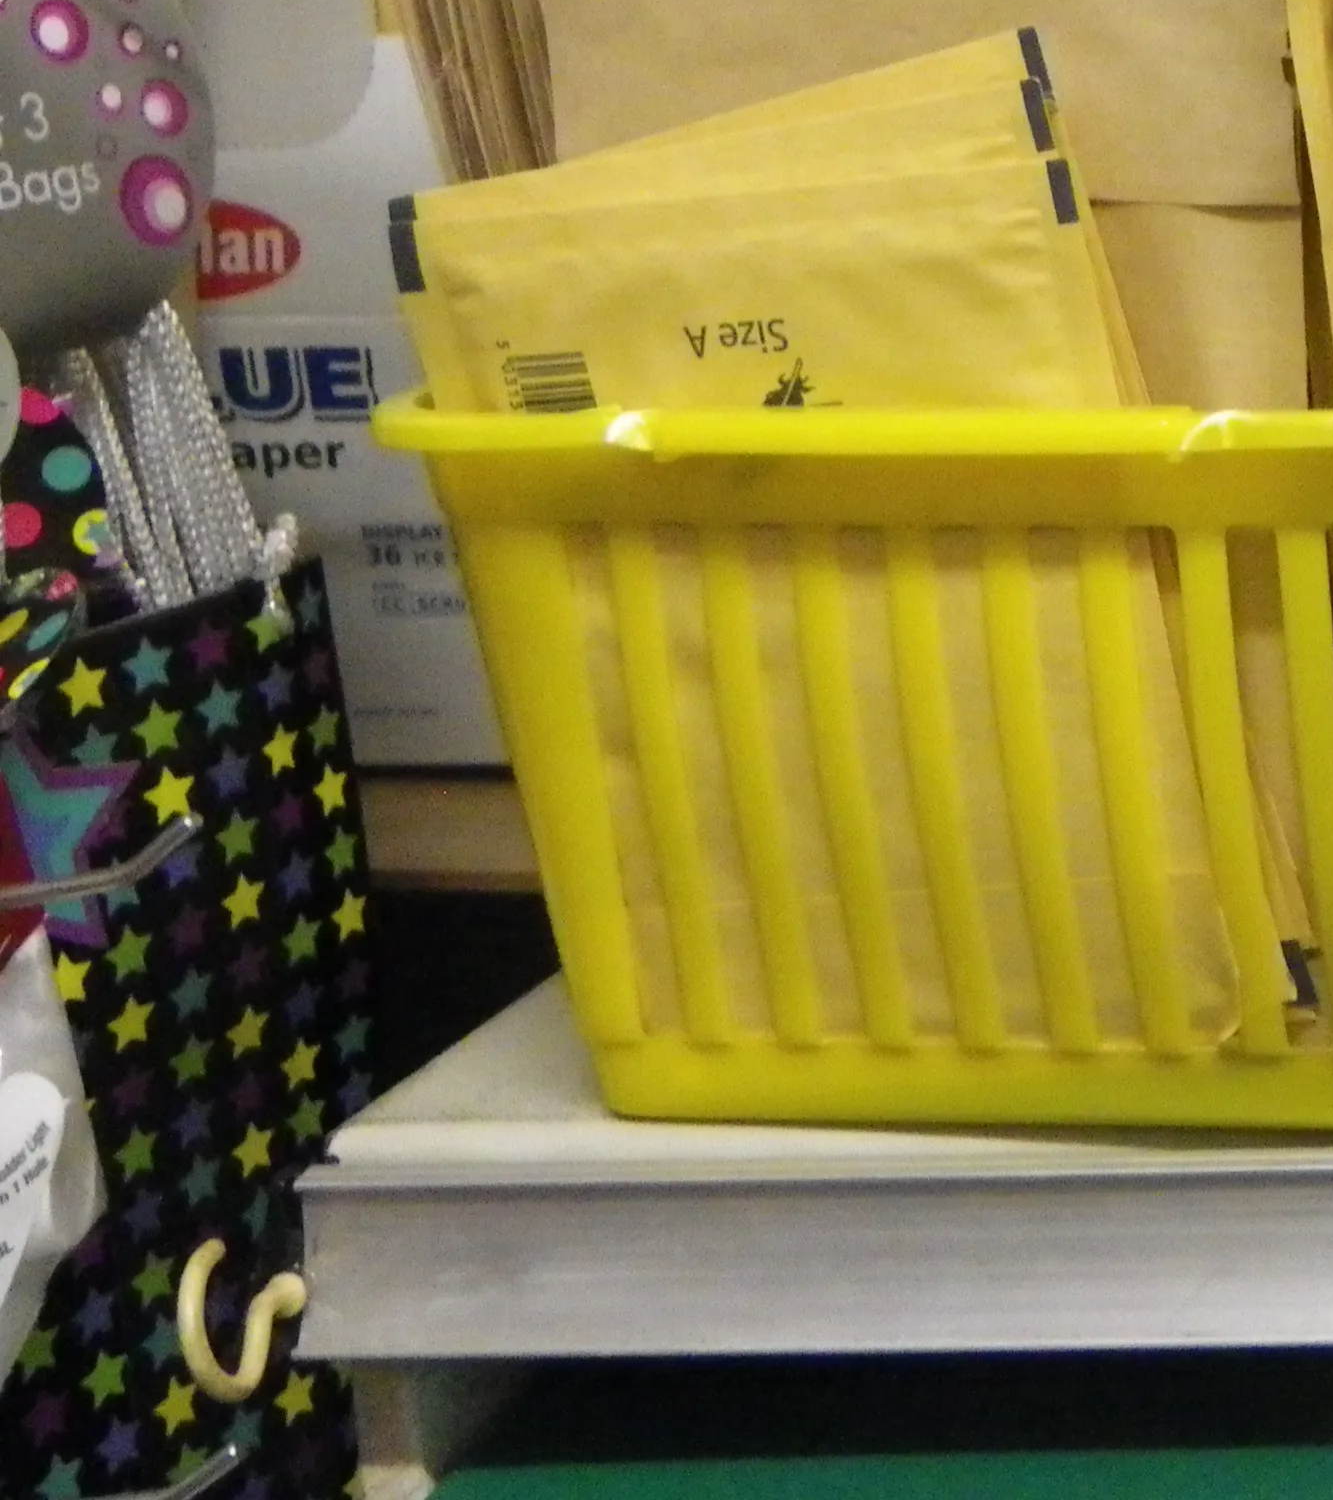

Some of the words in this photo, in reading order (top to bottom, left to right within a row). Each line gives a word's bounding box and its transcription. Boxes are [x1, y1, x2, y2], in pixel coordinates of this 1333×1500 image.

[20, 91, 50, 141] 3
[0, 161, 101, 214] Bags
[682, 325, 707, 359] A
[719, 318, 789, 353] Size
